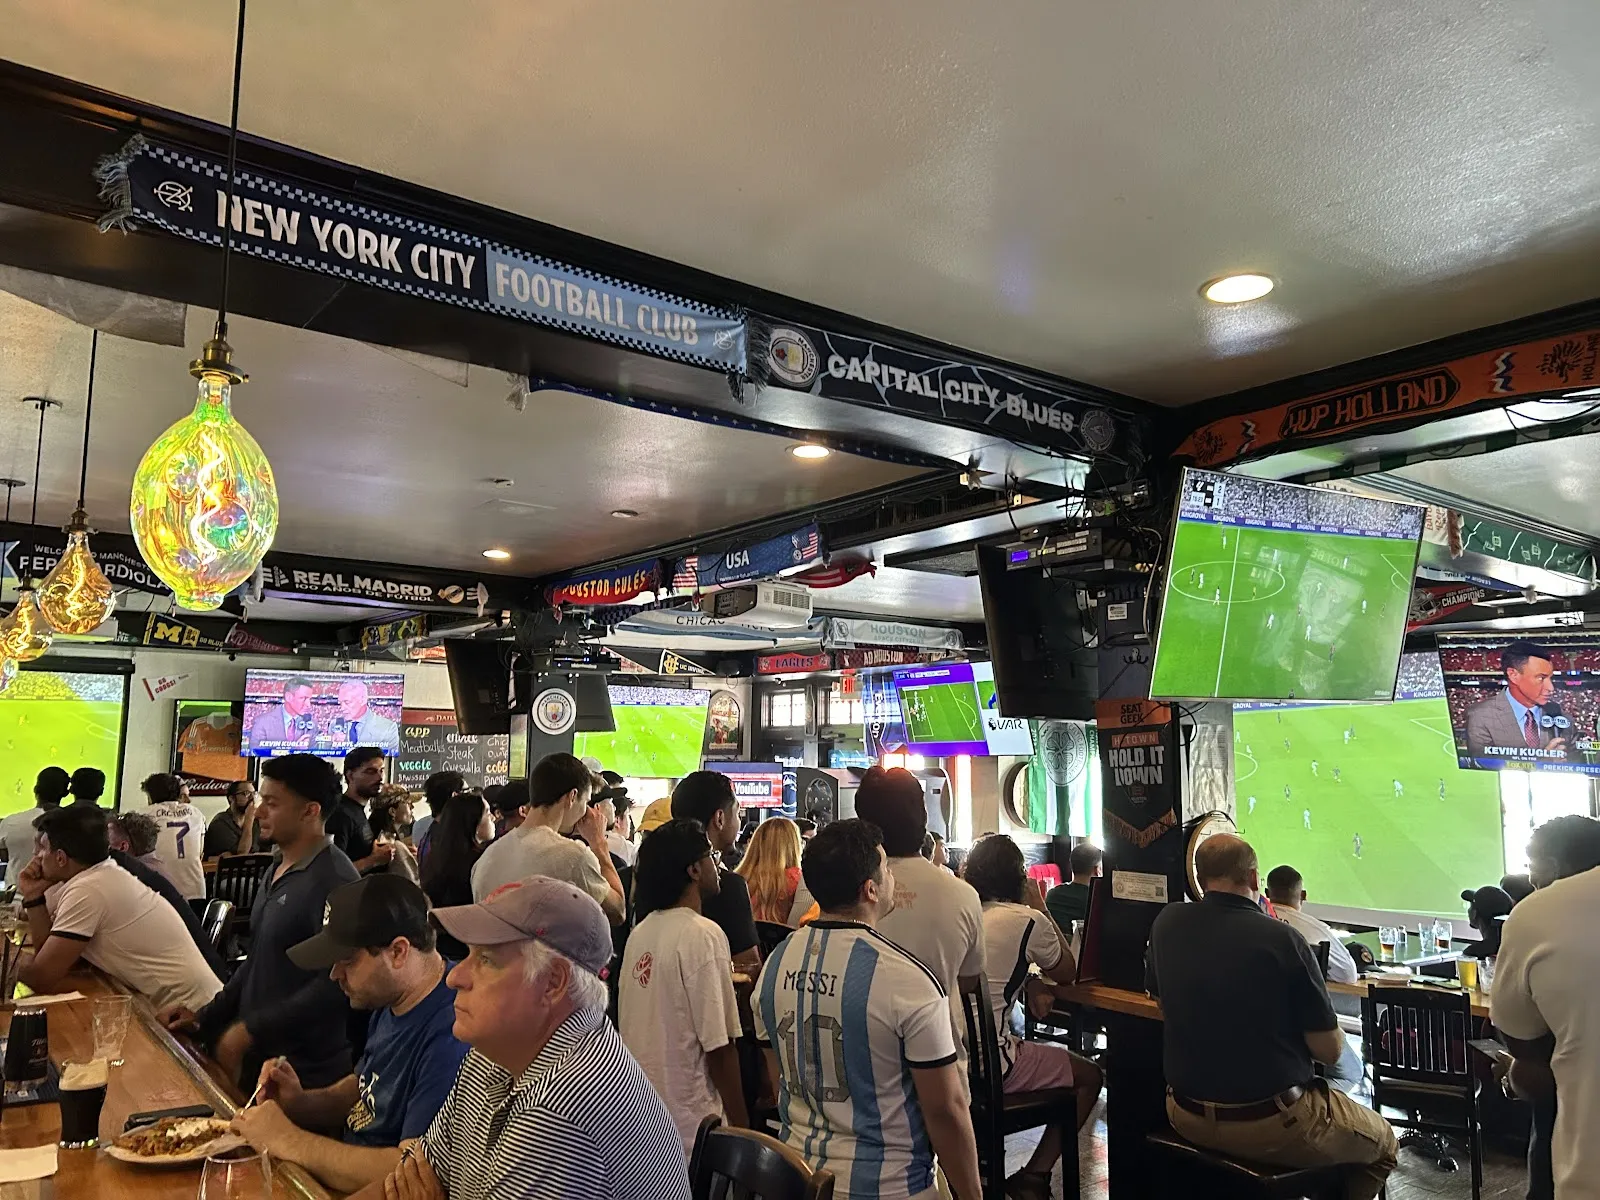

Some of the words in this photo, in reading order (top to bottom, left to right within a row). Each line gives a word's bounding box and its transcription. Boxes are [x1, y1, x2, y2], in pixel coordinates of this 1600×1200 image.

[216, 189, 300, 245] NEW
[310, 215, 402, 273] YORK
[411, 243, 475, 289] CITY
[496, 262, 631, 330] FOOTBALL
[637, 305, 698, 345] CLUB
[828, 354, 938, 398] CAPITAL
[945, 379, 999, 409] CITY
[1006, 392, 1074, 433] BLUES
[1283, 405, 1330, 435] HUP
[1335, 376, 1447, 425] HOLLAND
[1181, 511, 1206, 520] KINGROYAL
[1213, 515, 1236, 523] KINGROYAL
[1245, 518, 1266, 526] KINGROYAL
[99, 551, 151, 572] MANCHEST
[726, 550, 750, 570] USA
[96, 562, 169, 590] RDIOLA
[293, 570, 348, 587] REAL
[353, 575, 432, 597] MADRID
[1442, 589, 1486, 607] CHAMPIONS
[676, 616, 726, 626] CHICA
[870, 624, 926, 638] HOUSTON
[154, 621, 182, 643] M
[872, 693, 883, 739] Evon
[1121, 702, 1143, 714] SEAT
[998, 718, 1024, 730] VAR
[1120, 713, 1144, 725] GEEK
[405, 727, 430, 738] app
[487, 738, 508, 747] Chic
[400, 738, 445, 753] Meatballs
[446, 745, 474, 761] Steak
[1484, 746, 1517, 756] KEVIN
[1520, 748, 1565, 758] KUGLER
[1109, 747, 1145, 768] HOLD
[1149, 745, 1164, 765] IT
[1114, 765, 1162, 786] DOWN
[1543, 763, 1573, 772] PREKICK
[735, 783, 770, 795] YouTube
[167, 821, 190, 859] 7
[784, 970, 838, 997] MESSI
[777, 1010, 851, 1103] 10
